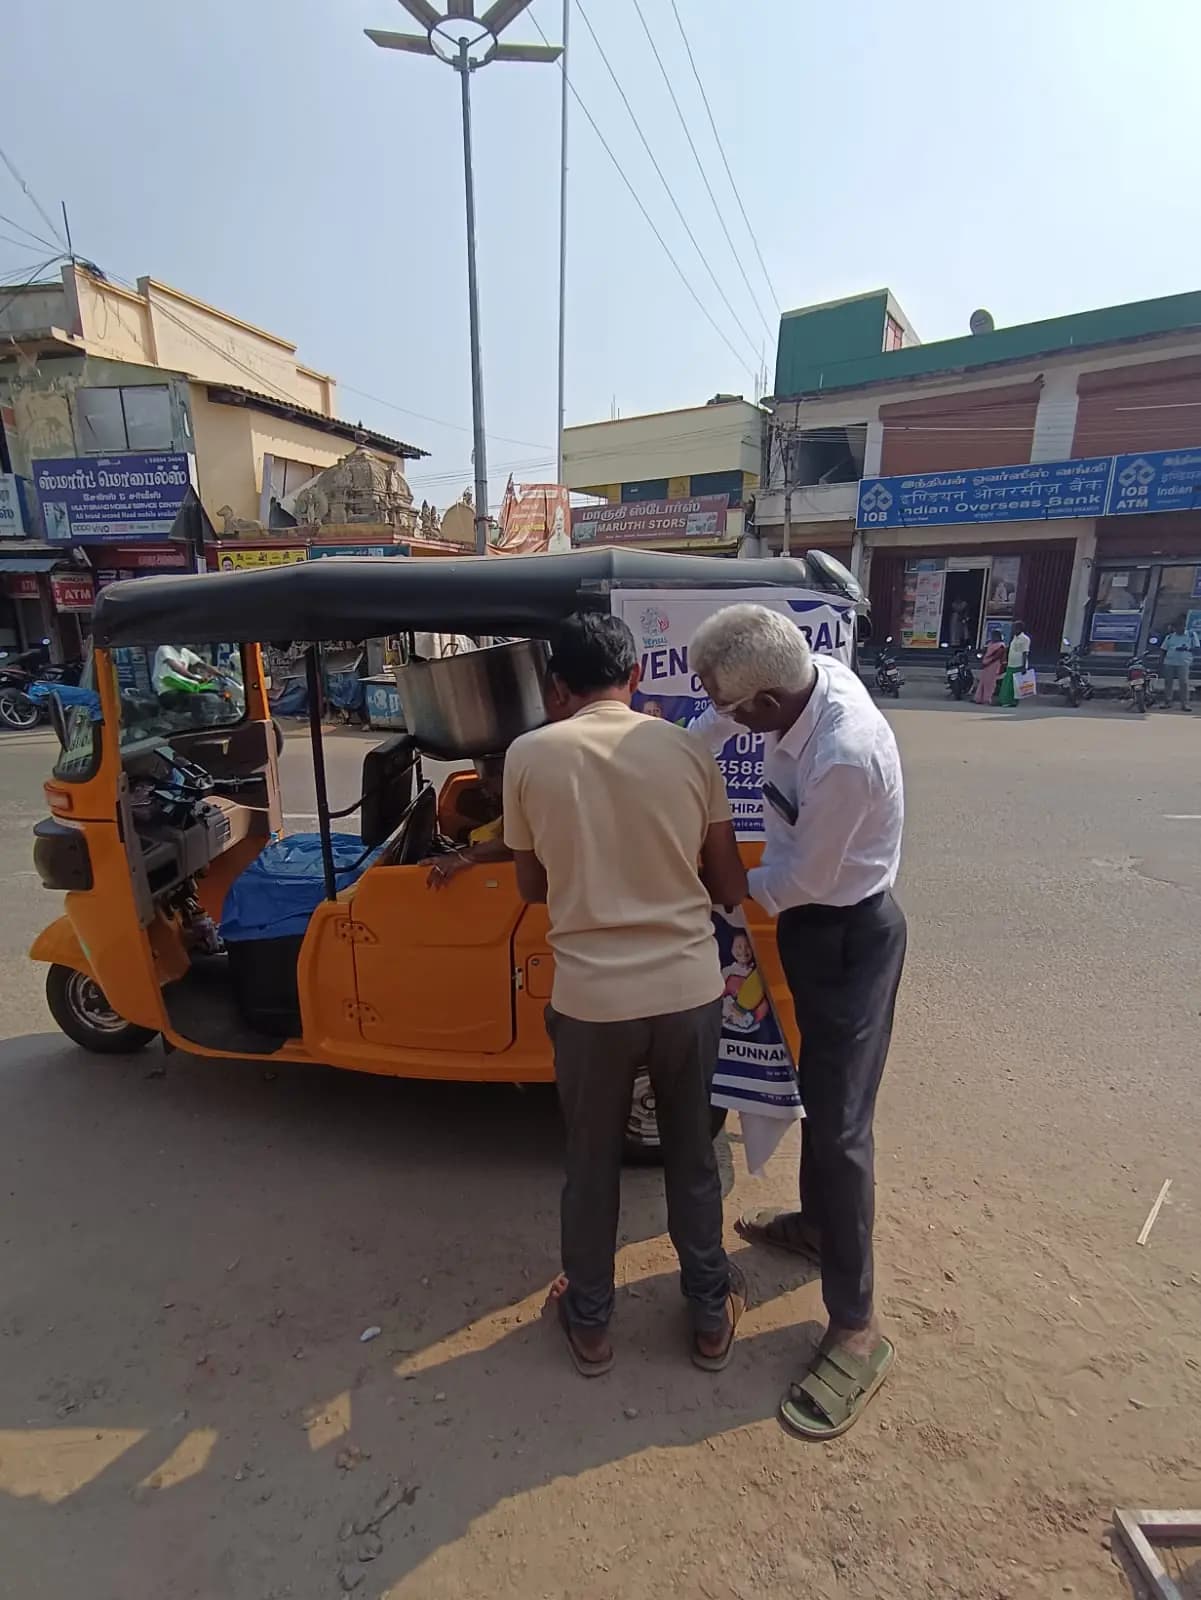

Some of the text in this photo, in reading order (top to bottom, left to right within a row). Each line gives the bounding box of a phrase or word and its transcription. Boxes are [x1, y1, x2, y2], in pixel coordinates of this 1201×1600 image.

[98, 465, 187, 488] மொபைல்ஸ்
[1120, 486, 1149, 497] IOB
[954, 499, 1042, 513] Overseas
[1047, 493, 1101, 507] Bank
[1116, 498, 1149, 510] ATM
[863, 511, 889, 523] IOB
[597, 518, 687, 533] MARUTHI STORS
[64, 588, 92, 600] ATM
[638, 620, 846, 682] VEN BAL
[736, 732, 764, 755] OP
[718, 759, 764, 776] 3588
[723, 775, 764, 790] 444
